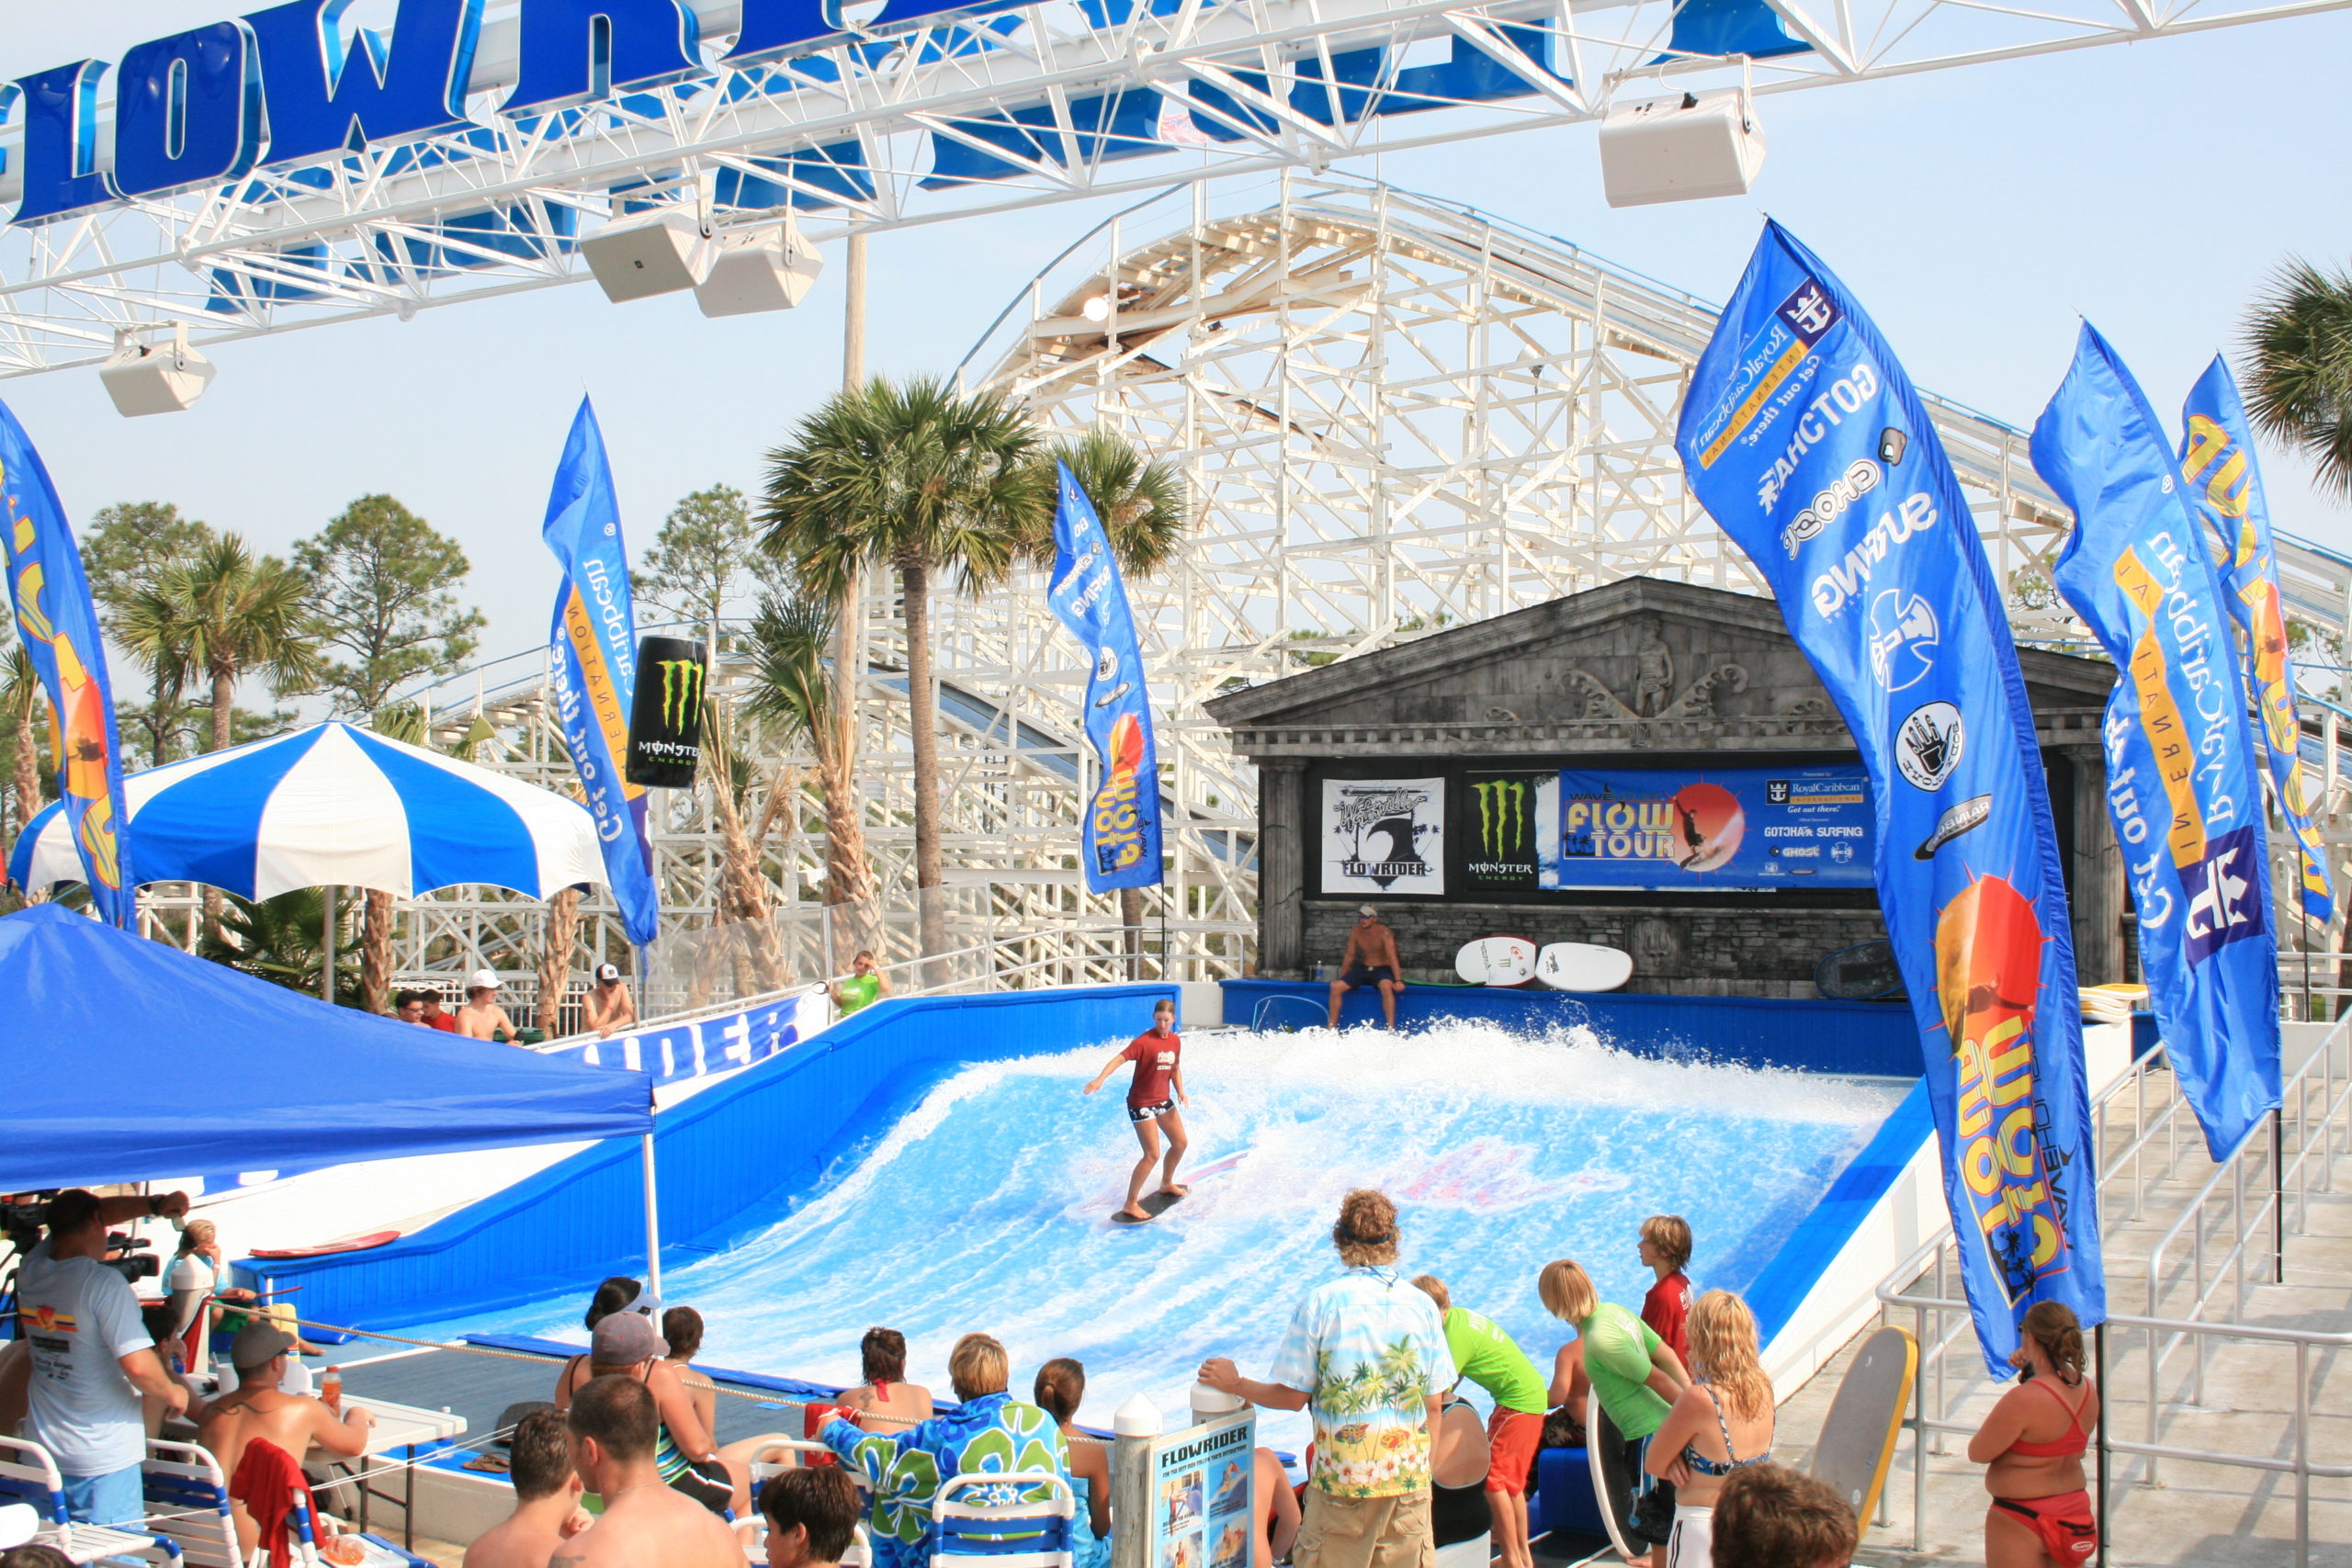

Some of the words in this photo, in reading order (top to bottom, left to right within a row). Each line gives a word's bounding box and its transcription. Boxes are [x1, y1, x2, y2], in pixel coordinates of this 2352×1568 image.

[649, 756, 695, 766] ENERG
[1792, 782, 1860, 795] RoyalCaribbean
[1787, 805, 1802, 814] Get
[1566, 802, 1675, 833] FLOW
[1815, 826, 1864, 838] SURFING
[1590, 831, 1676, 858] TOUR
[1341, 862, 1427, 876] FLOWRIDER
[1468, 862, 1532, 874] MONSTER
[1161, 1425, 1249, 1469] FLOWRIDER
